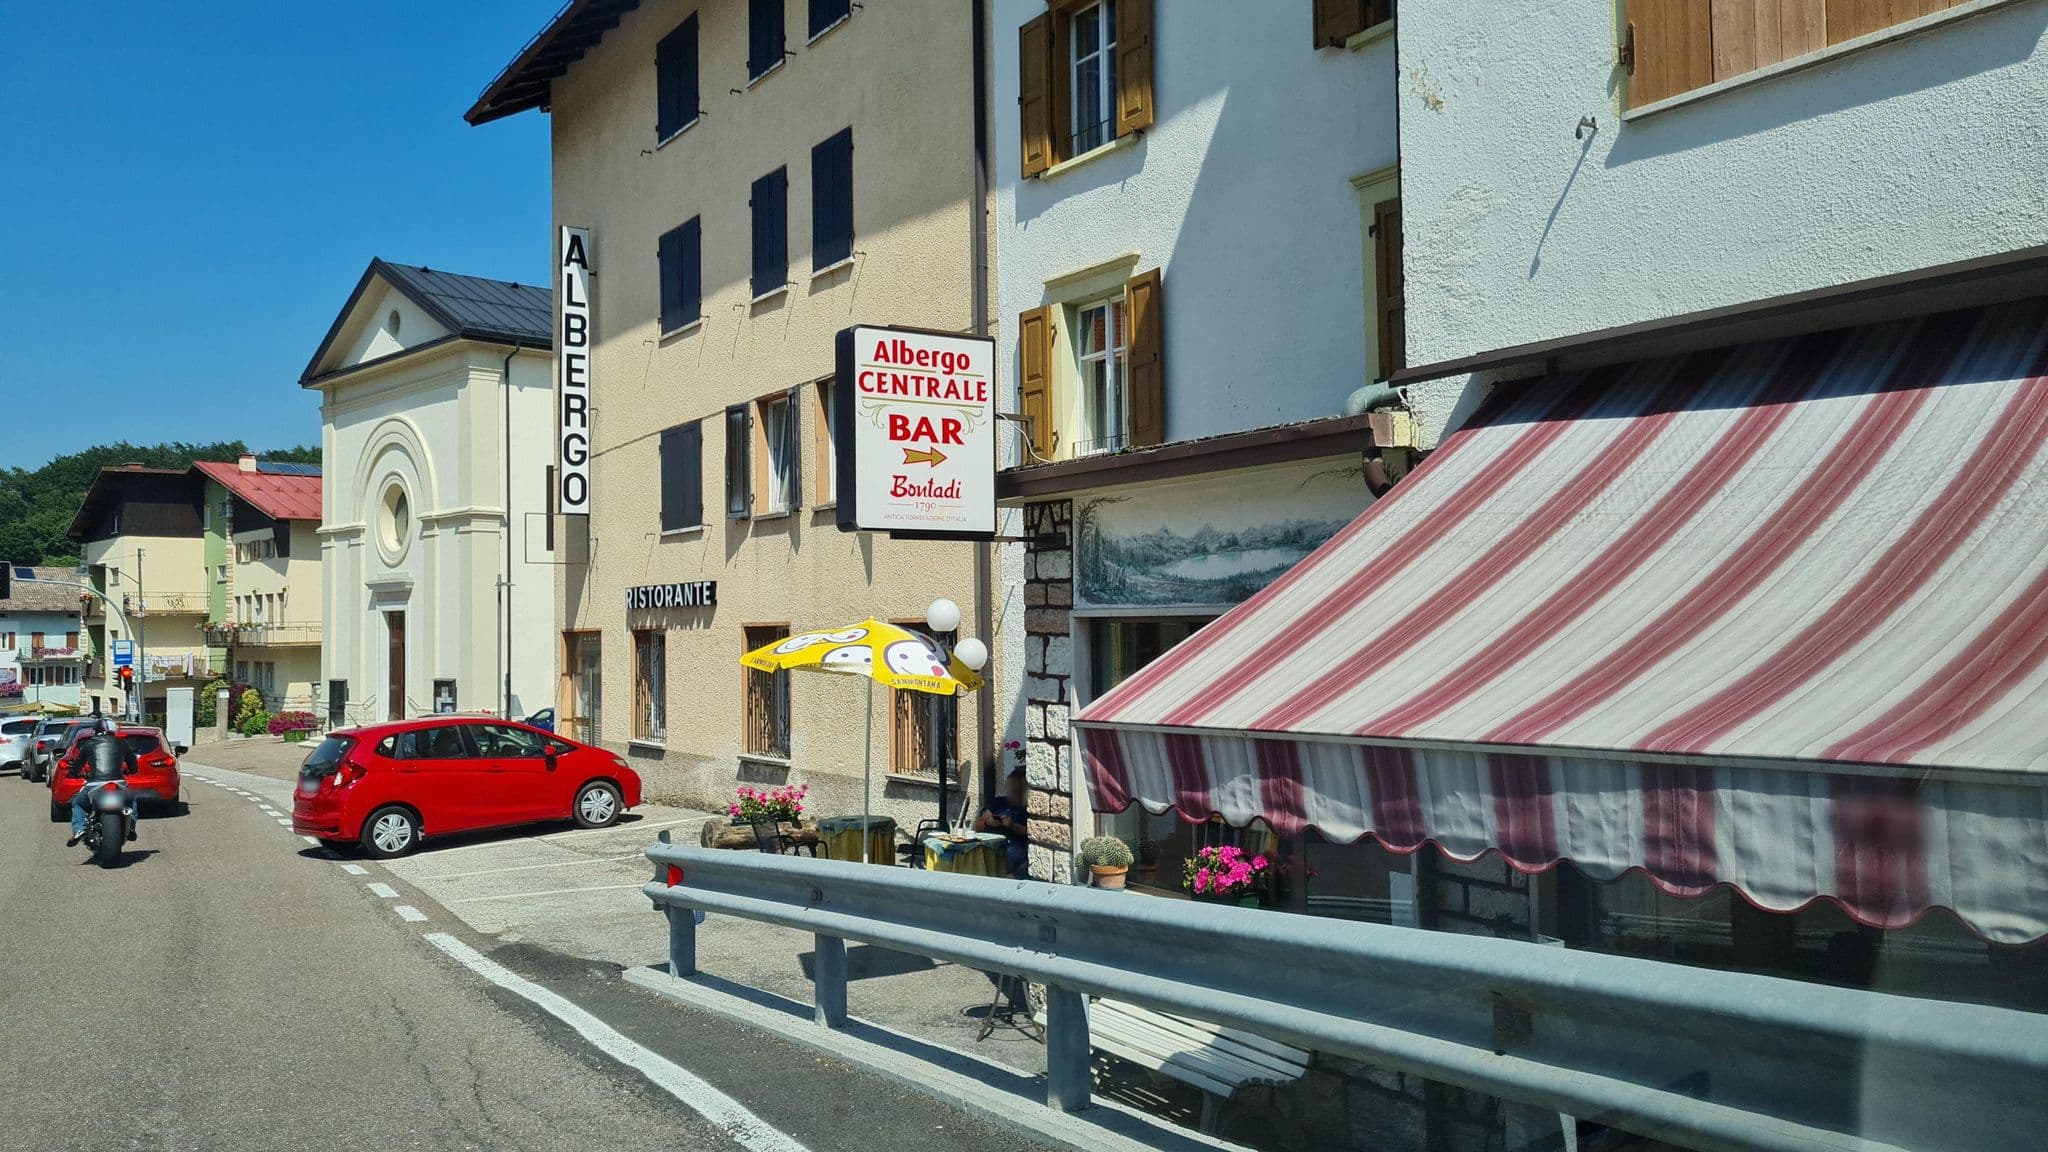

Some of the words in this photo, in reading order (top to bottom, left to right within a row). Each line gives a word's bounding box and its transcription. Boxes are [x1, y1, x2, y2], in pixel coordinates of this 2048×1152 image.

[563, 234, 589, 506] ALBERGO
[873, 339, 971, 375] Albergo
[858, 371, 988, 402] CENTRALE
[888, 413, 965, 445] BAR
[890, 475, 962, 499] Bontadi
[915, 501, 937, 512] 1790
[625, 581, 712, 609] RISTORANTE
[891, 678, 941, 689] SAMMONTANA
